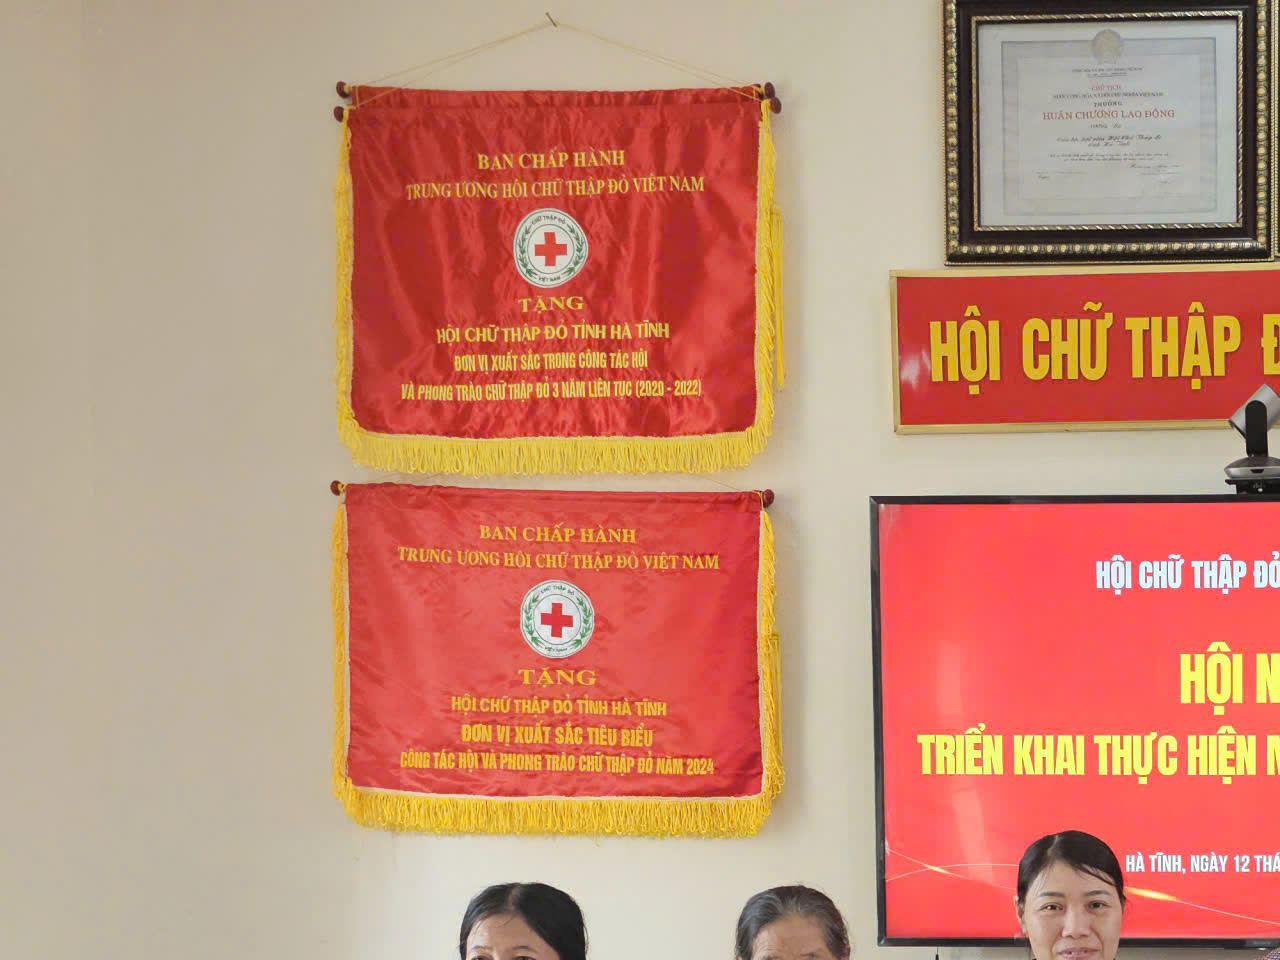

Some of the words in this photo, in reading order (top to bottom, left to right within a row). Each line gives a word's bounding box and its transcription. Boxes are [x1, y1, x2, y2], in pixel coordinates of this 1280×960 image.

[478, 152, 513, 170] BAN
[519, 147, 568, 168] CHẤP
[573, 148, 624, 166] HÀNH
[518, 296, 583, 314] TẶNG
[930, 306, 1001, 394] HỘI
[1022, 302, 1113, 380] CHỮ
[1126, 302, 1241, 389] THẬP
[543, 352, 575, 369] TRONG
[418, 384, 452, 400] PHONG
[552, 382, 559, 397] 3
[480, 525, 517, 540] BAN
[522, 522, 575, 543] CHẤP
[580, 525, 636, 543] HÀNH
[1096, 555, 1131, 595] HỘI
[1138, 555, 1185, 589] CHỮ
[1192, 555, 1247, 594] THẬP
[518, 667, 597, 687] TẶNG
[1180, 642, 1242, 715] HỘI
[462, 724, 491, 742] ĐƠN
[496, 725, 510, 746] VỊ
[514, 720, 551, 744] XUẤT
[555, 722, 583, 744] SẮC
[587, 725, 616, 746] TIÊU
[622, 722, 652, 747] BIỂU
[917, 722, 1004, 776] TRIỂN
[1014, 735, 1086, 775] KHAI
[1095, 735, 1178, 785] THỰC
[1187, 726, 1255, 785] HIỆN
[1126, 851, 1147, 874] HÀ
[1149, 852, 1186, 877] TĨNH,
[1191, 851, 1228, 874] NGÀY
[1233, 855, 1250, 873] 12
